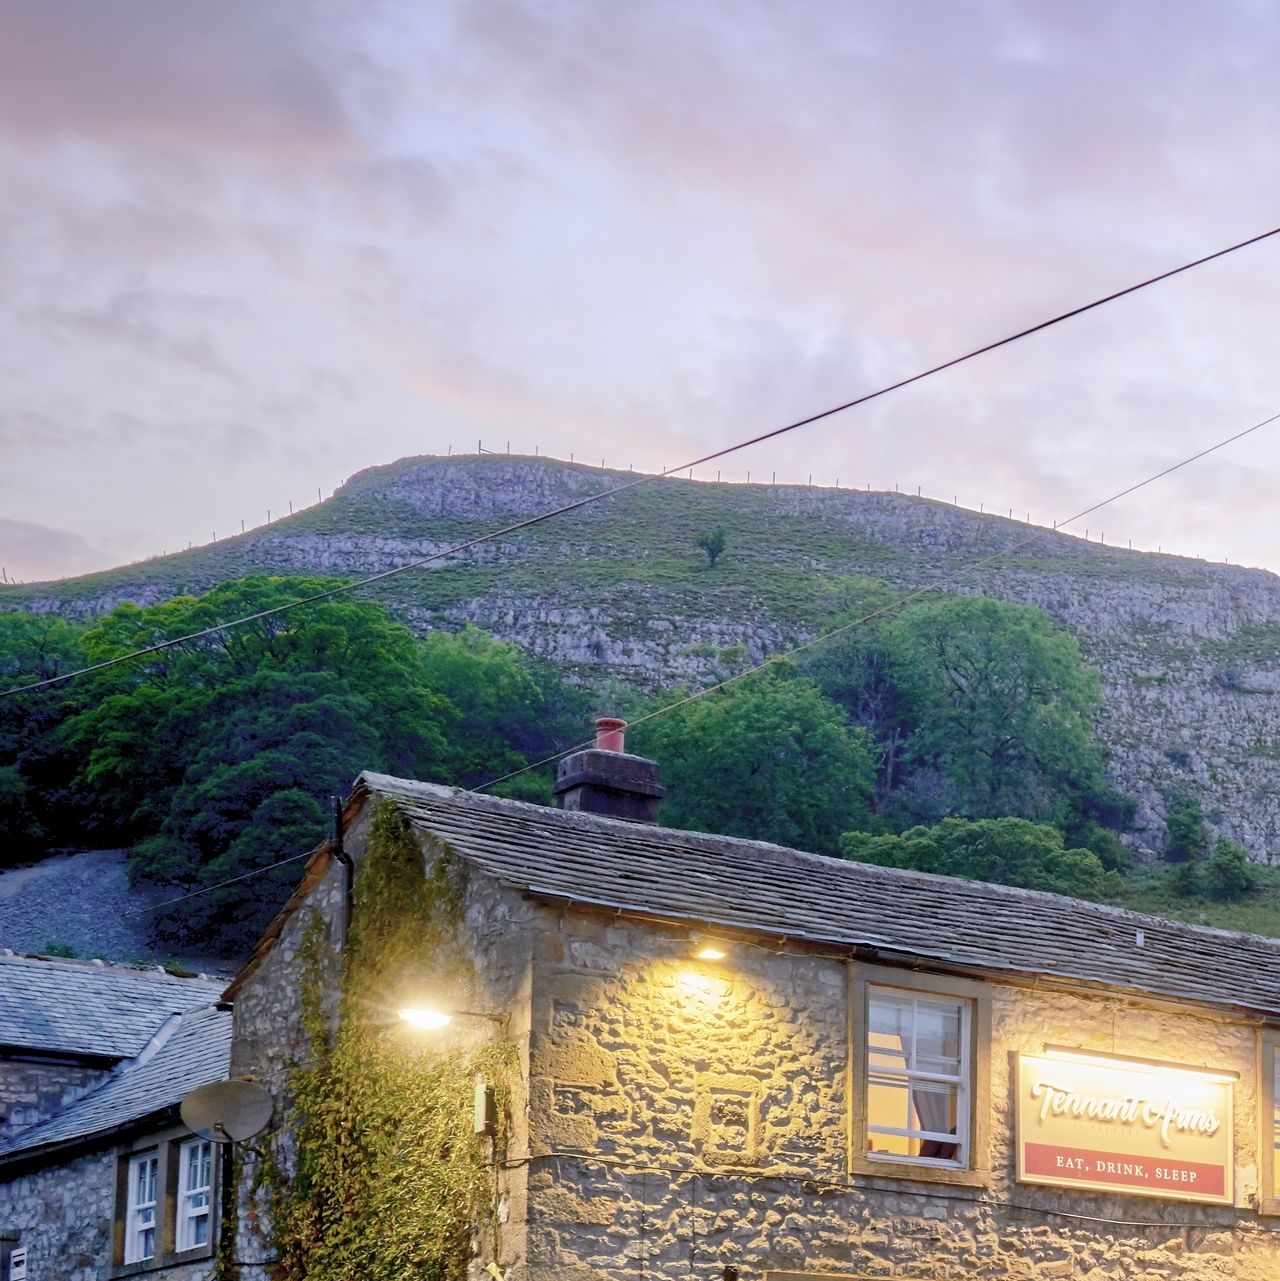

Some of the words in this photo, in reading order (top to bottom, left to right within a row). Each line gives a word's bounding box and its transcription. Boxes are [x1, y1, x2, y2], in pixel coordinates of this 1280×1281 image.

[1032, 1080, 1143, 1124] Tennant
[1142, 1099, 1221, 1144] Arms
[1056, 1155, 1090, 1171] EAT,
[1096, 1160, 1149, 1178] DRINK,
[1155, 1167, 1197, 1183] SLEEP
